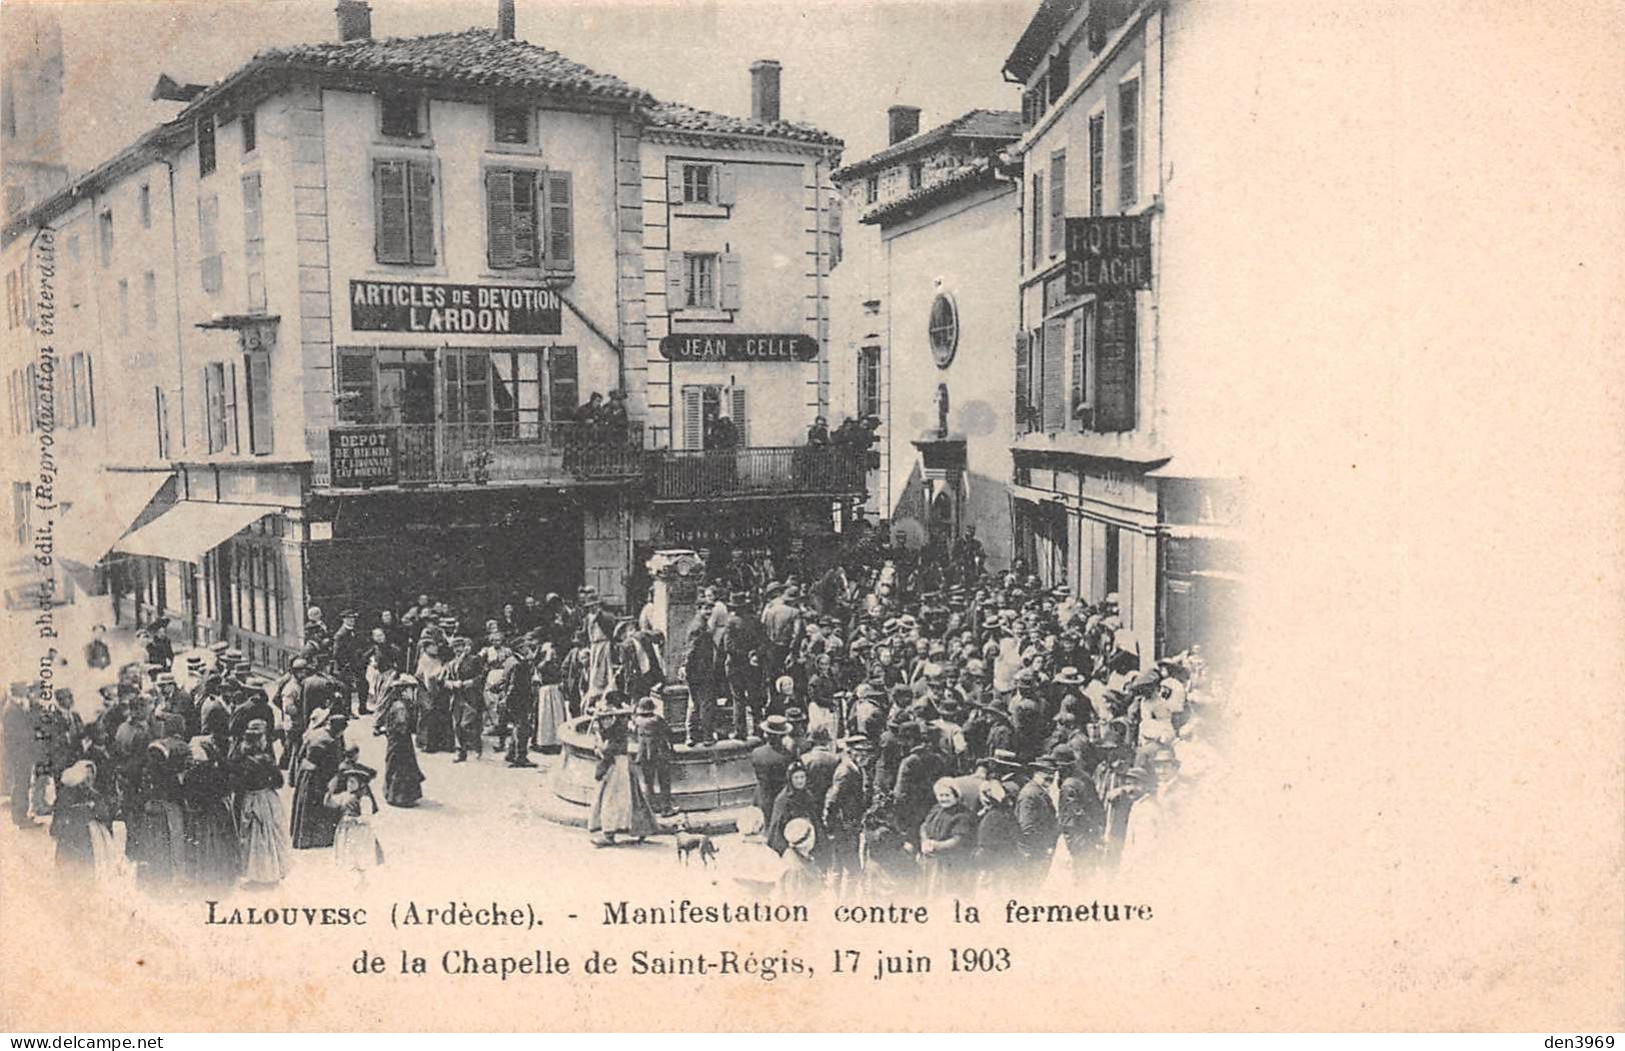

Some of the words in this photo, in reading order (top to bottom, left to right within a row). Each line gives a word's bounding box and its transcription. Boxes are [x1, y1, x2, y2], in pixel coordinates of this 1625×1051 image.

[1071, 221, 1142, 253] HOTEL
[353, 284, 446, 305] ARTICLES
[452, 291, 472, 304] DE
[478, 291, 560, 311] DEVOTION
[410, 308, 511, 333] LARDON
[680, 339, 727, 356] JEAN
[746, 339, 799, 356] CELLE
